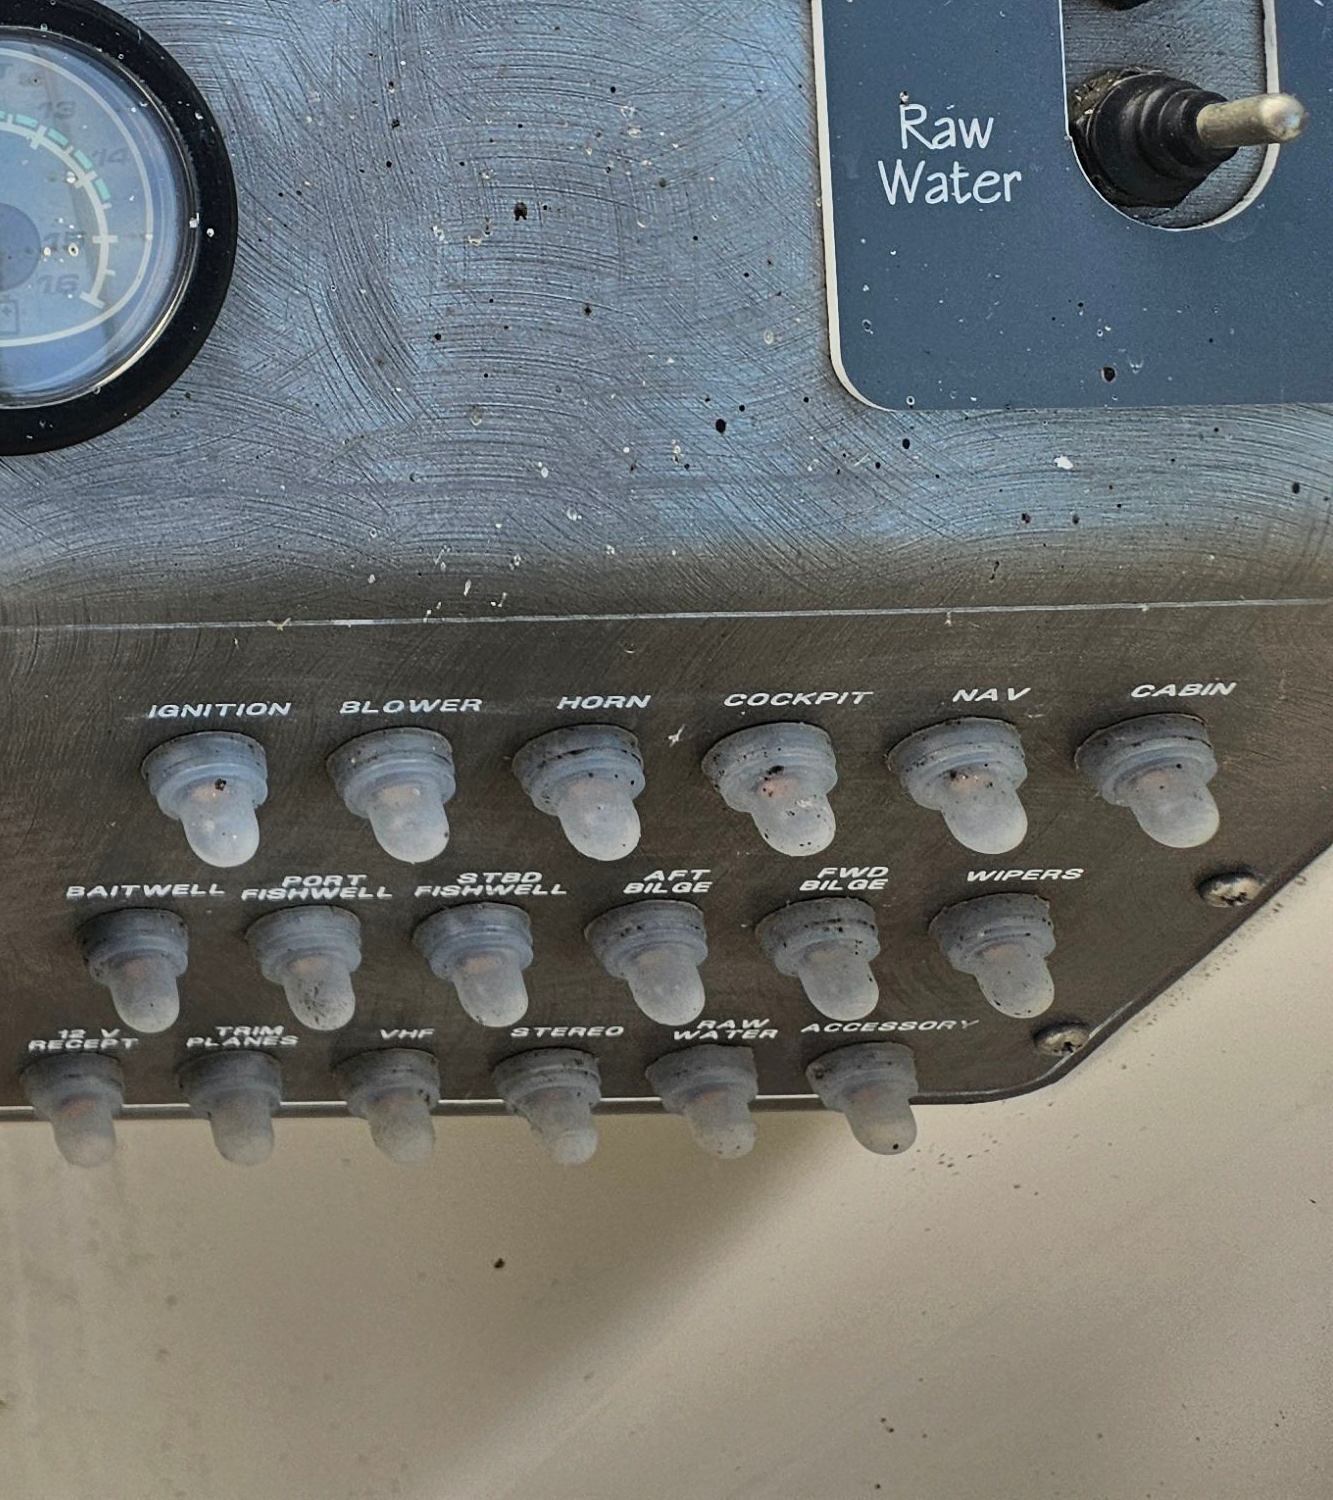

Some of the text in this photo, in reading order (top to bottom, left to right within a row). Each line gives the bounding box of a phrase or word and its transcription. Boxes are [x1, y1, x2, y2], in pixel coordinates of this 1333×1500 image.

[36, 101, 76, 120] 13
[899, 104, 994, 151] Raw
[92, 145, 130, 166] 14
[878, 159, 1022, 206] Water
[35, 274, 79, 294] 16
[951, 686, 1032, 703] NAV
[1130, 681, 1237, 699] CABIN
[339, 698, 483, 715] BLOWER
[556, 695, 651, 711] HORN
[723, 691, 874, 708] COCKPIT
[147, 702, 291, 720] IGNITION
[456, 871, 543, 885] STBD
[643, 869, 711, 881] AFT
[817, 866, 889, 878] FWD
[966, 867, 1085, 882] WIPERS
[281, 874, 367, 888] PORT
[622, 881, 713, 894] BILGE
[799, 878, 889, 891] BILGE
[65, 883, 226, 899] BAITWELL
[240, 886, 393, 901] FISHWELL
[414, 883, 567, 898] FISHWELL
[215, 1025, 285, 1038] TRIM
[510, 1025, 625, 1038] STEREO
[696, 1018, 771, 1030] RAW
[800, 1018, 980, 1034] ACCESSORY
[58, 1028, 121, 1040] 12 V
[379, 1028, 435, 1041] VHF
[673, 1029, 778, 1041] WATER
[28, 1037, 139, 1051] RECEPT
[186, 1035, 300, 1049] PLANES
